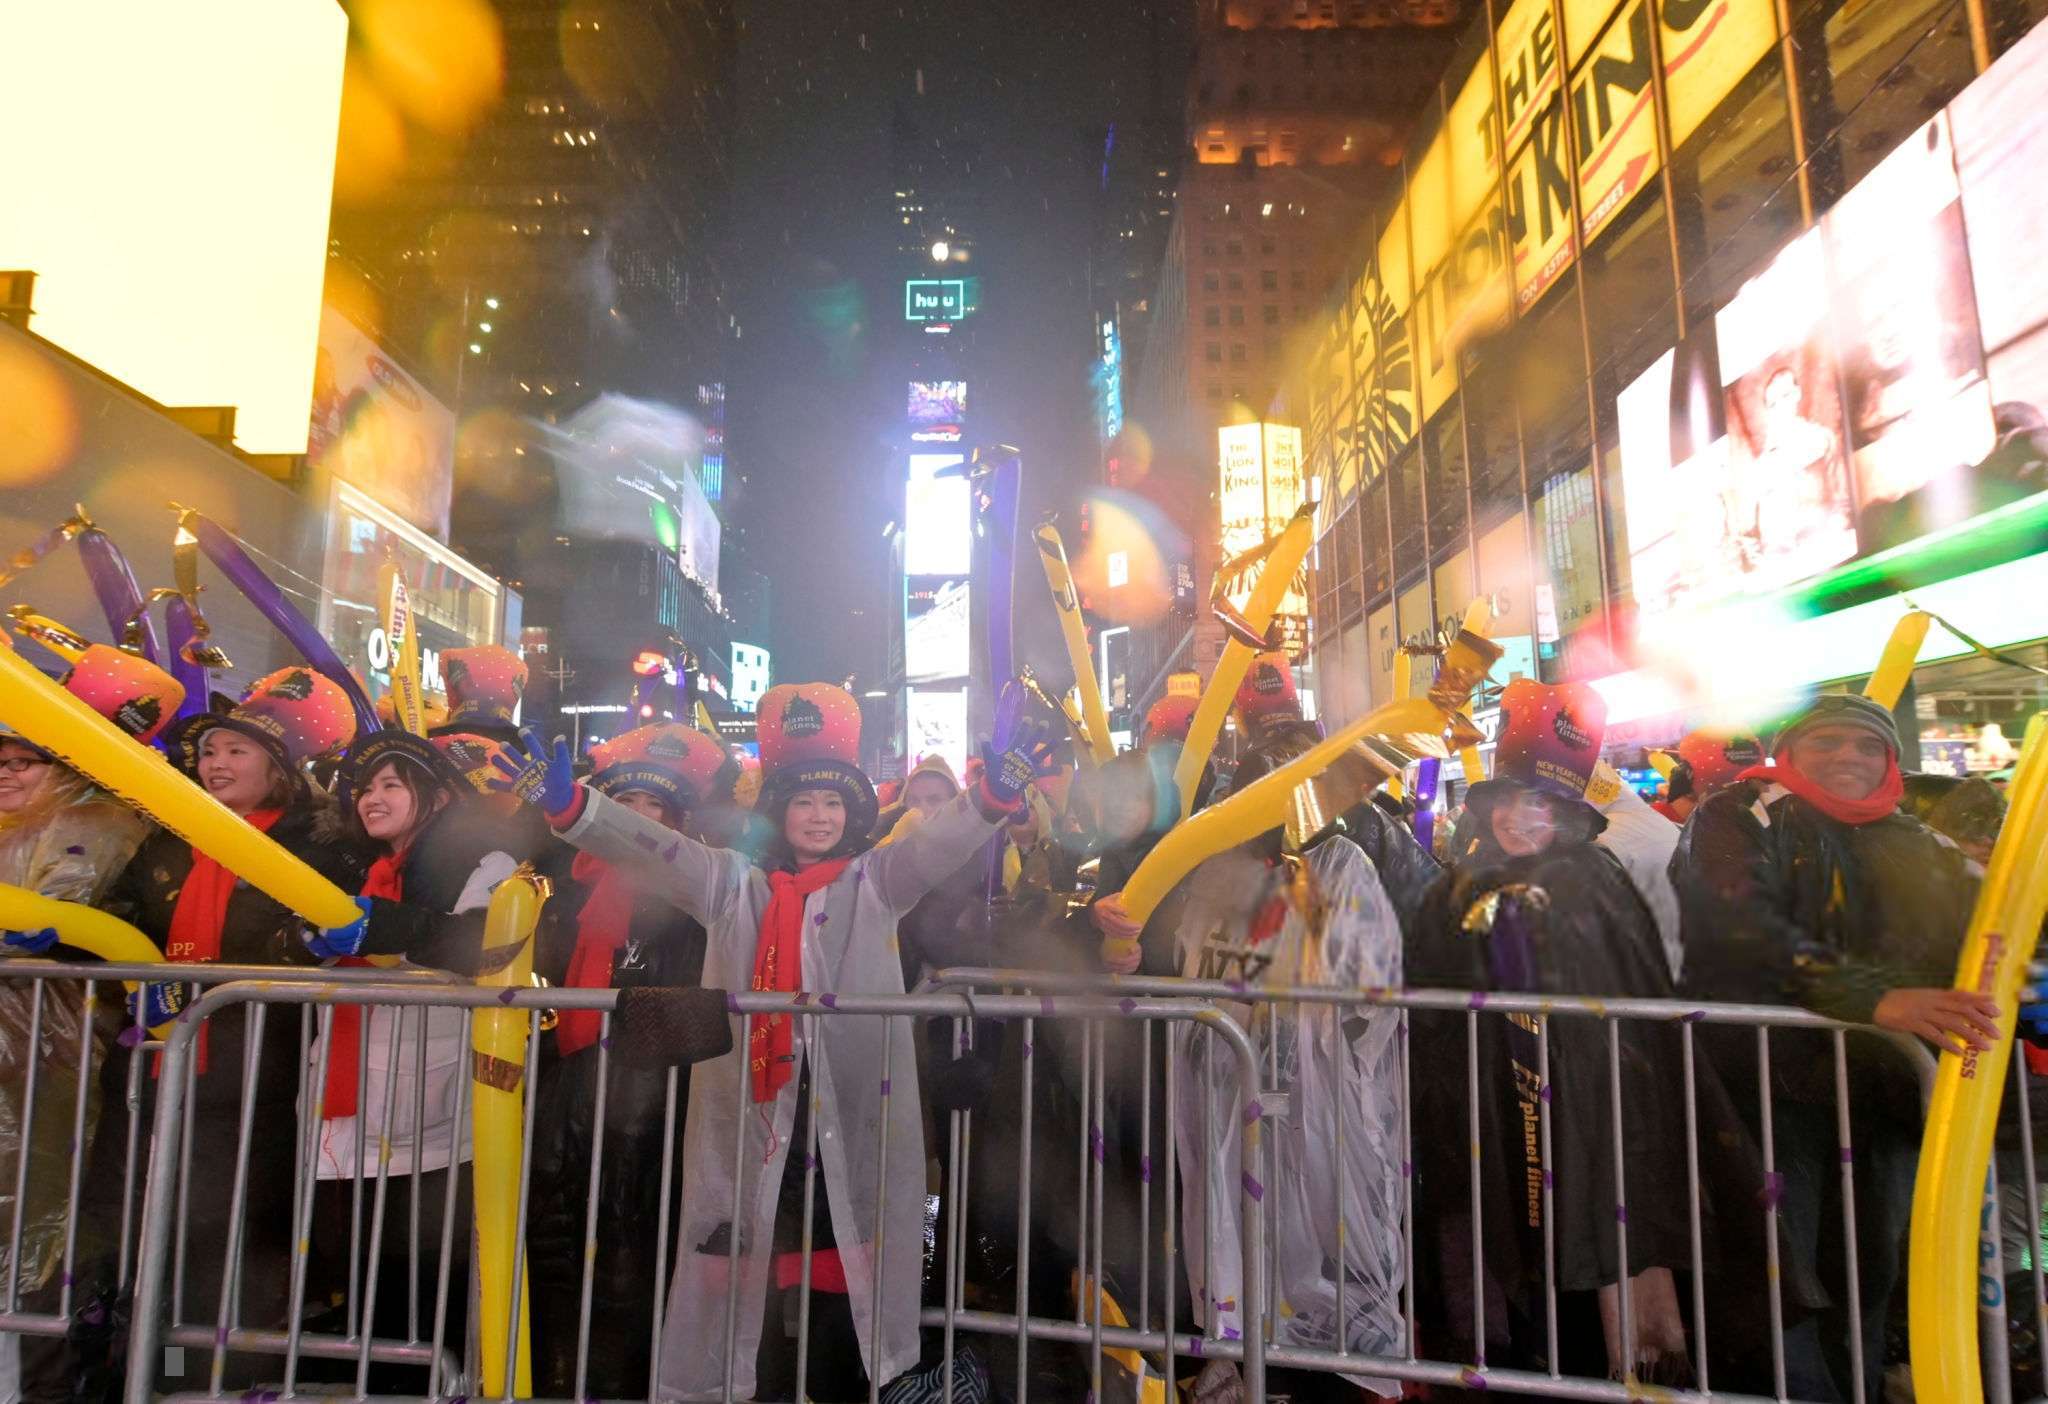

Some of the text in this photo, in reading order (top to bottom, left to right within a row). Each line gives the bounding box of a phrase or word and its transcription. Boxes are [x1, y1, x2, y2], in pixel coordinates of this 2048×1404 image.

[1477, 8, 1558, 168] THE
[1520, 277, 1539, 303] ON
[1583, 178, 1625, 234] STREET
[1103, 320, 1118, 439] NEW YEAR
[1224, 473, 1259, 493] KING
[1225, 455, 1255, 472] LION
[1559, 727, 1591, 747] fitness
[800, 771, 842, 783] PLANET
[1519, 1100, 1544, 1228] planet fitness
